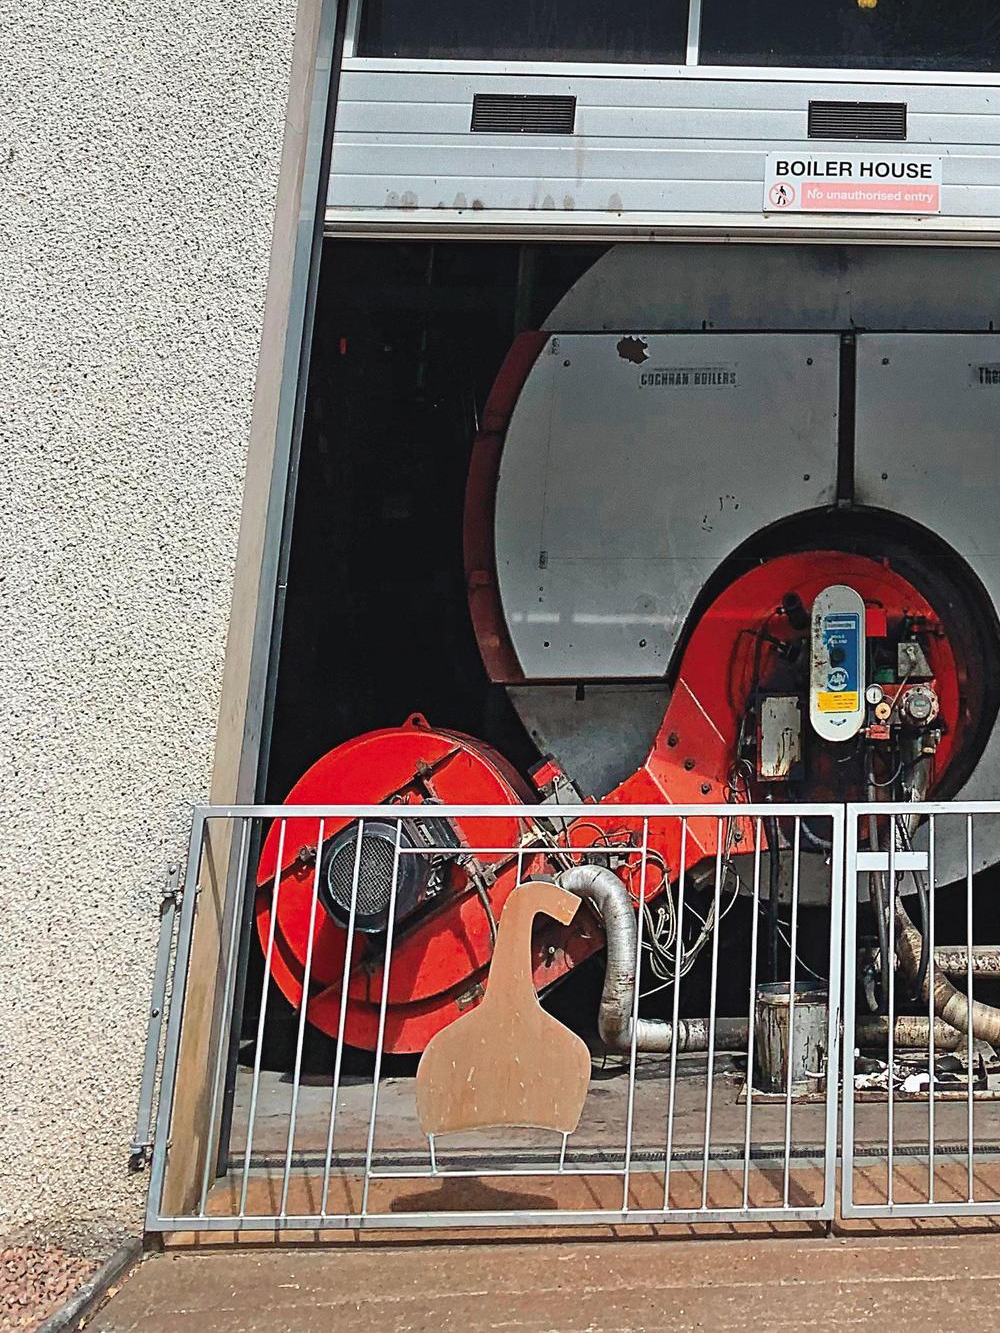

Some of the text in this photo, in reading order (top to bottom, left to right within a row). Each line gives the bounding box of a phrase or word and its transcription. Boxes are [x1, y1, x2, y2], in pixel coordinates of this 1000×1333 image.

[776, 160, 933, 179] BOILER HOUSE
[807, 189, 934, 204] No unauthorised entry
[641, 372, 737, 386] COCHRAN BOILERS
